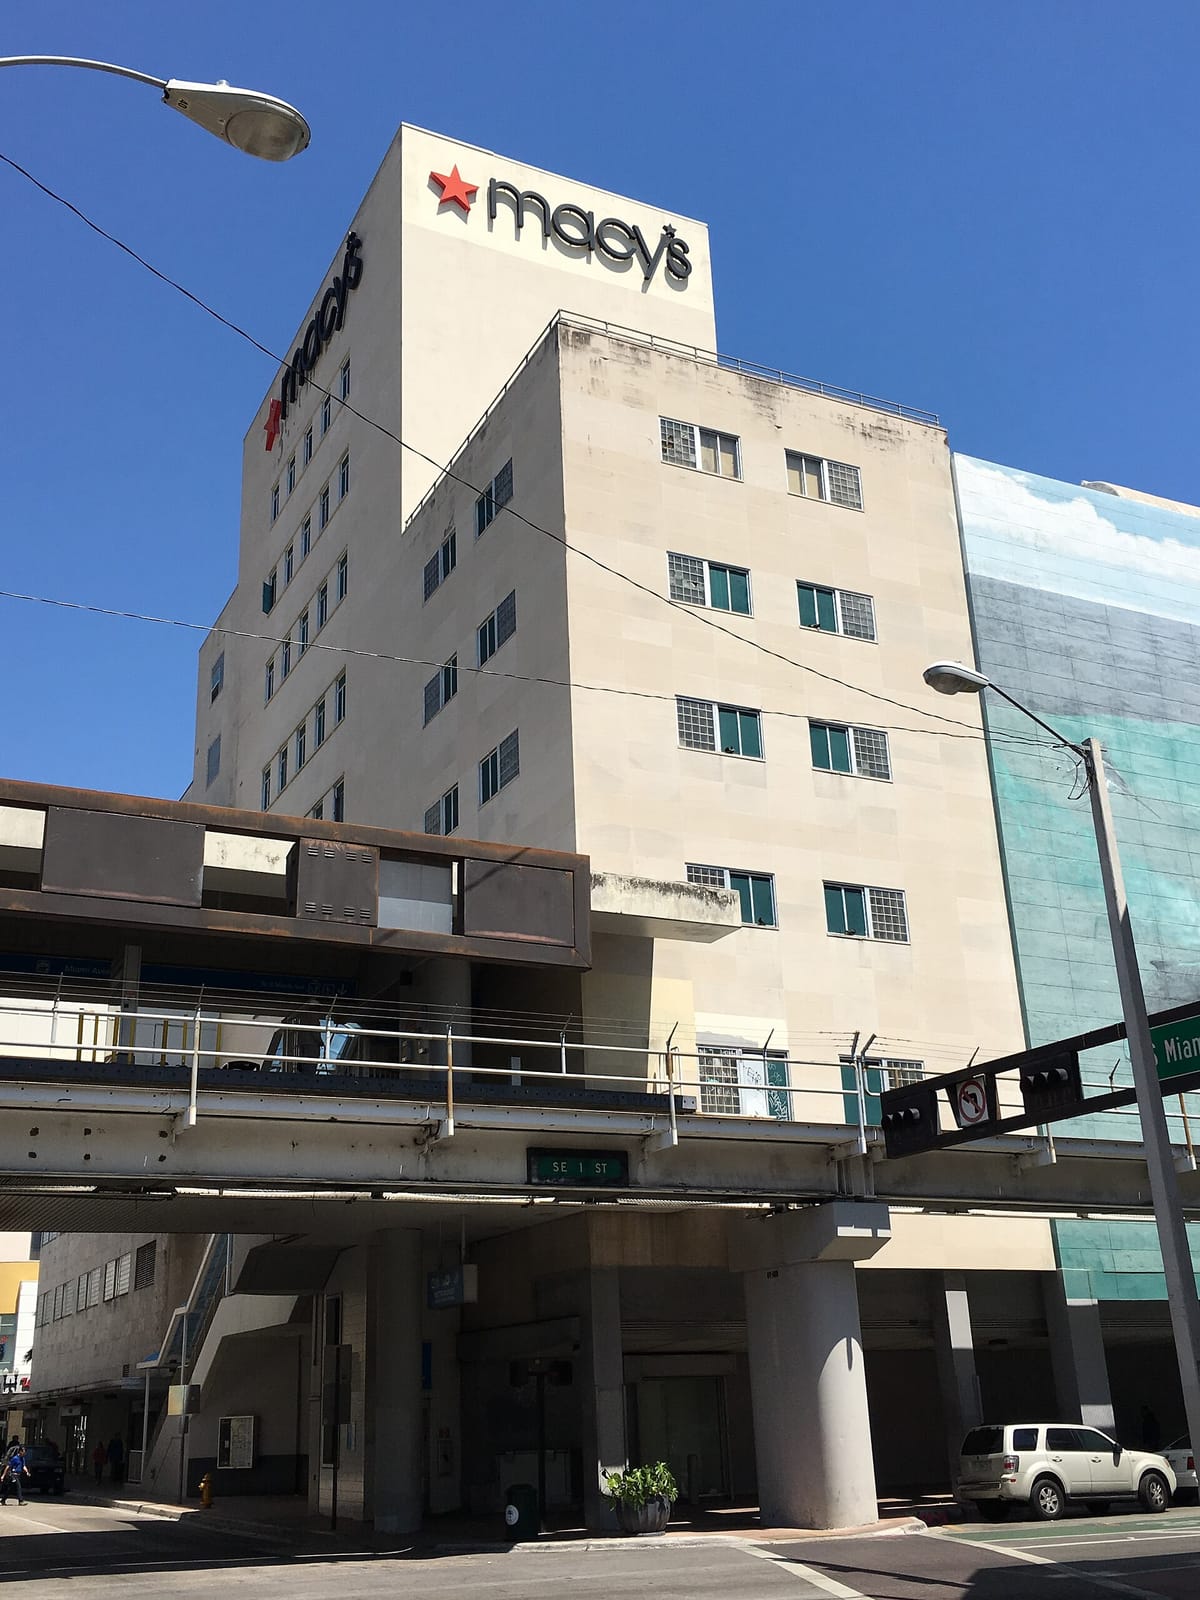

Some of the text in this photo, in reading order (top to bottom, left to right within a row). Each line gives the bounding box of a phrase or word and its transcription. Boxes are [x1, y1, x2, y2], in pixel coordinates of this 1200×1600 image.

[488, 177, 693, 281] macy's
[552, 1161, 568, 1173] SE
[595, 1162, 608, 1174] ST
